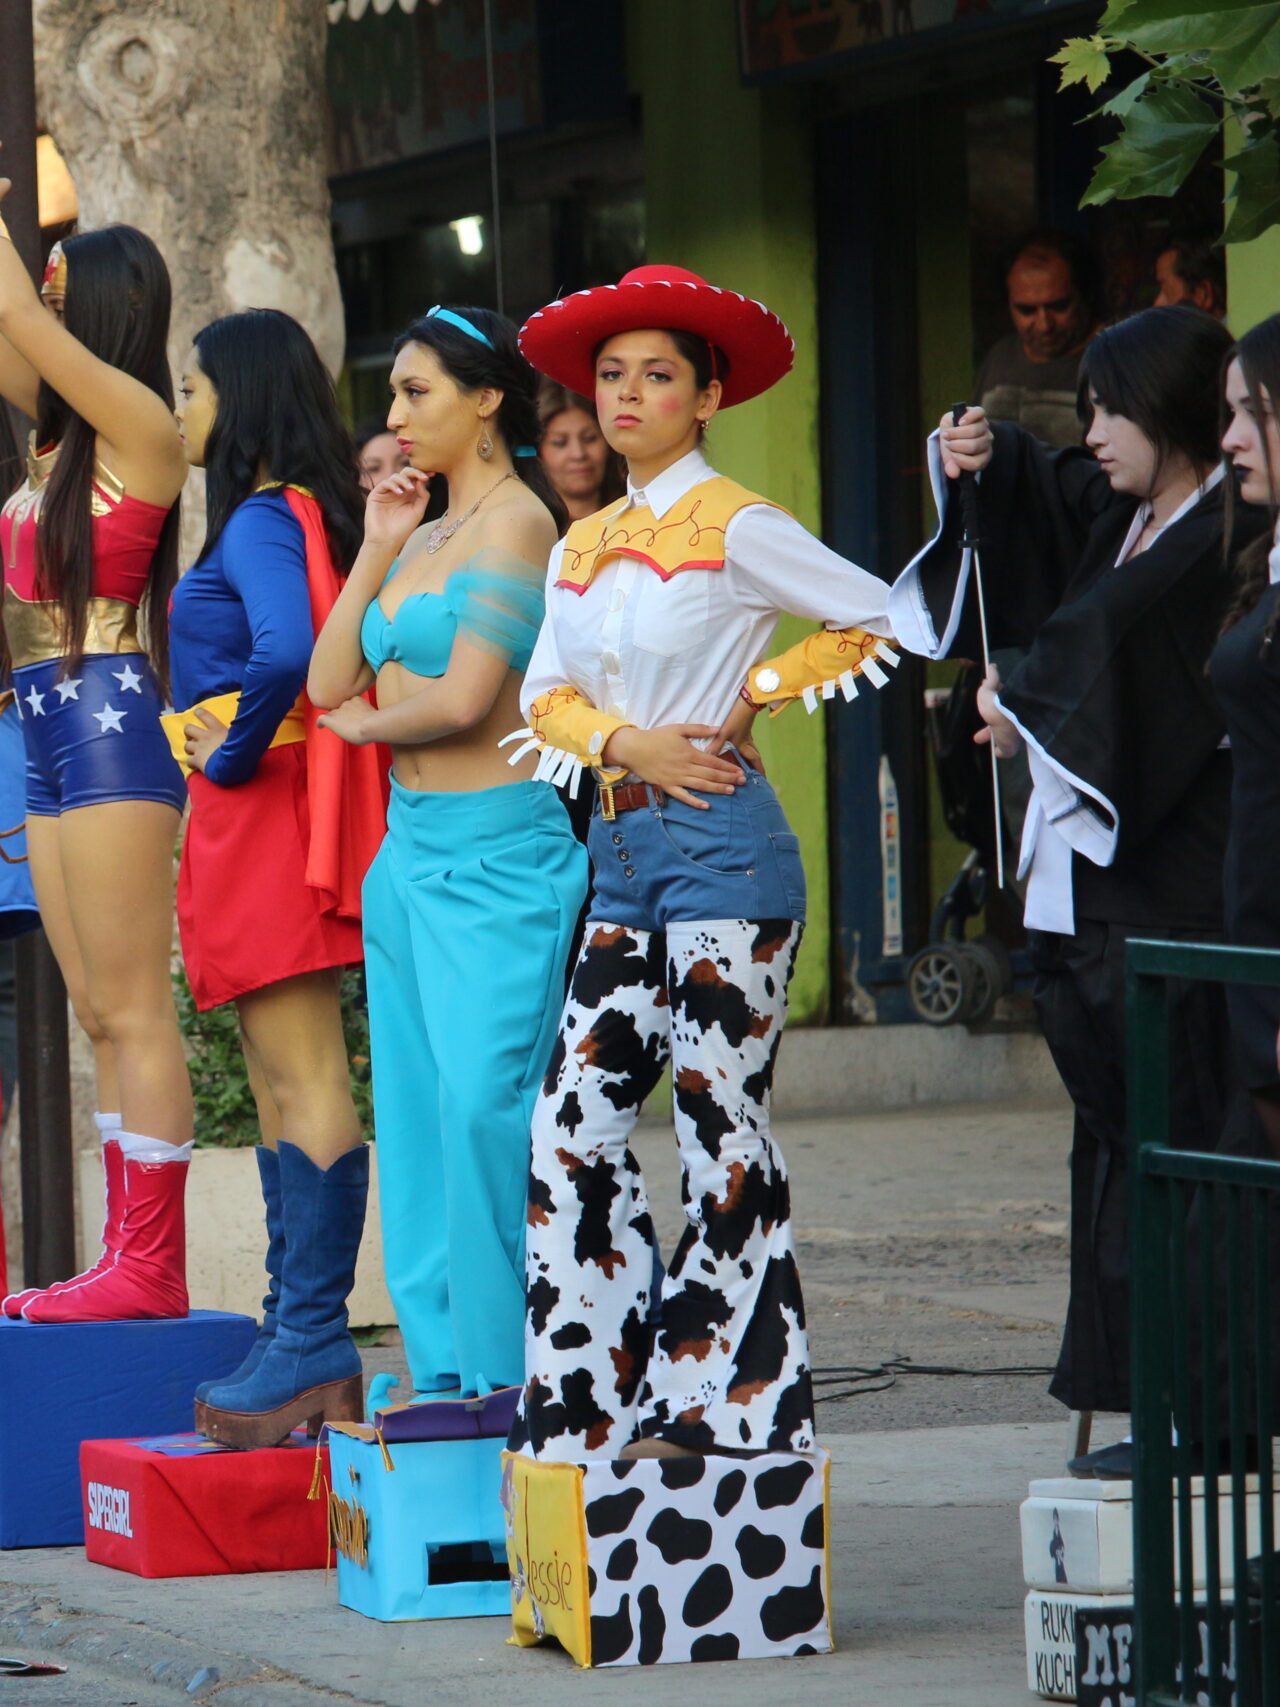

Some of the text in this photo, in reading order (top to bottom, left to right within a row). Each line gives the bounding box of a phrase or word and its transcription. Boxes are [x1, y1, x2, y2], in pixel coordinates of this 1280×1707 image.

[88, 1481, 133, 1539] SUPERGIRL
[525, 1475, 573, 1611] Jessie
[1040, 1600, 1077, 1643] RUKI
